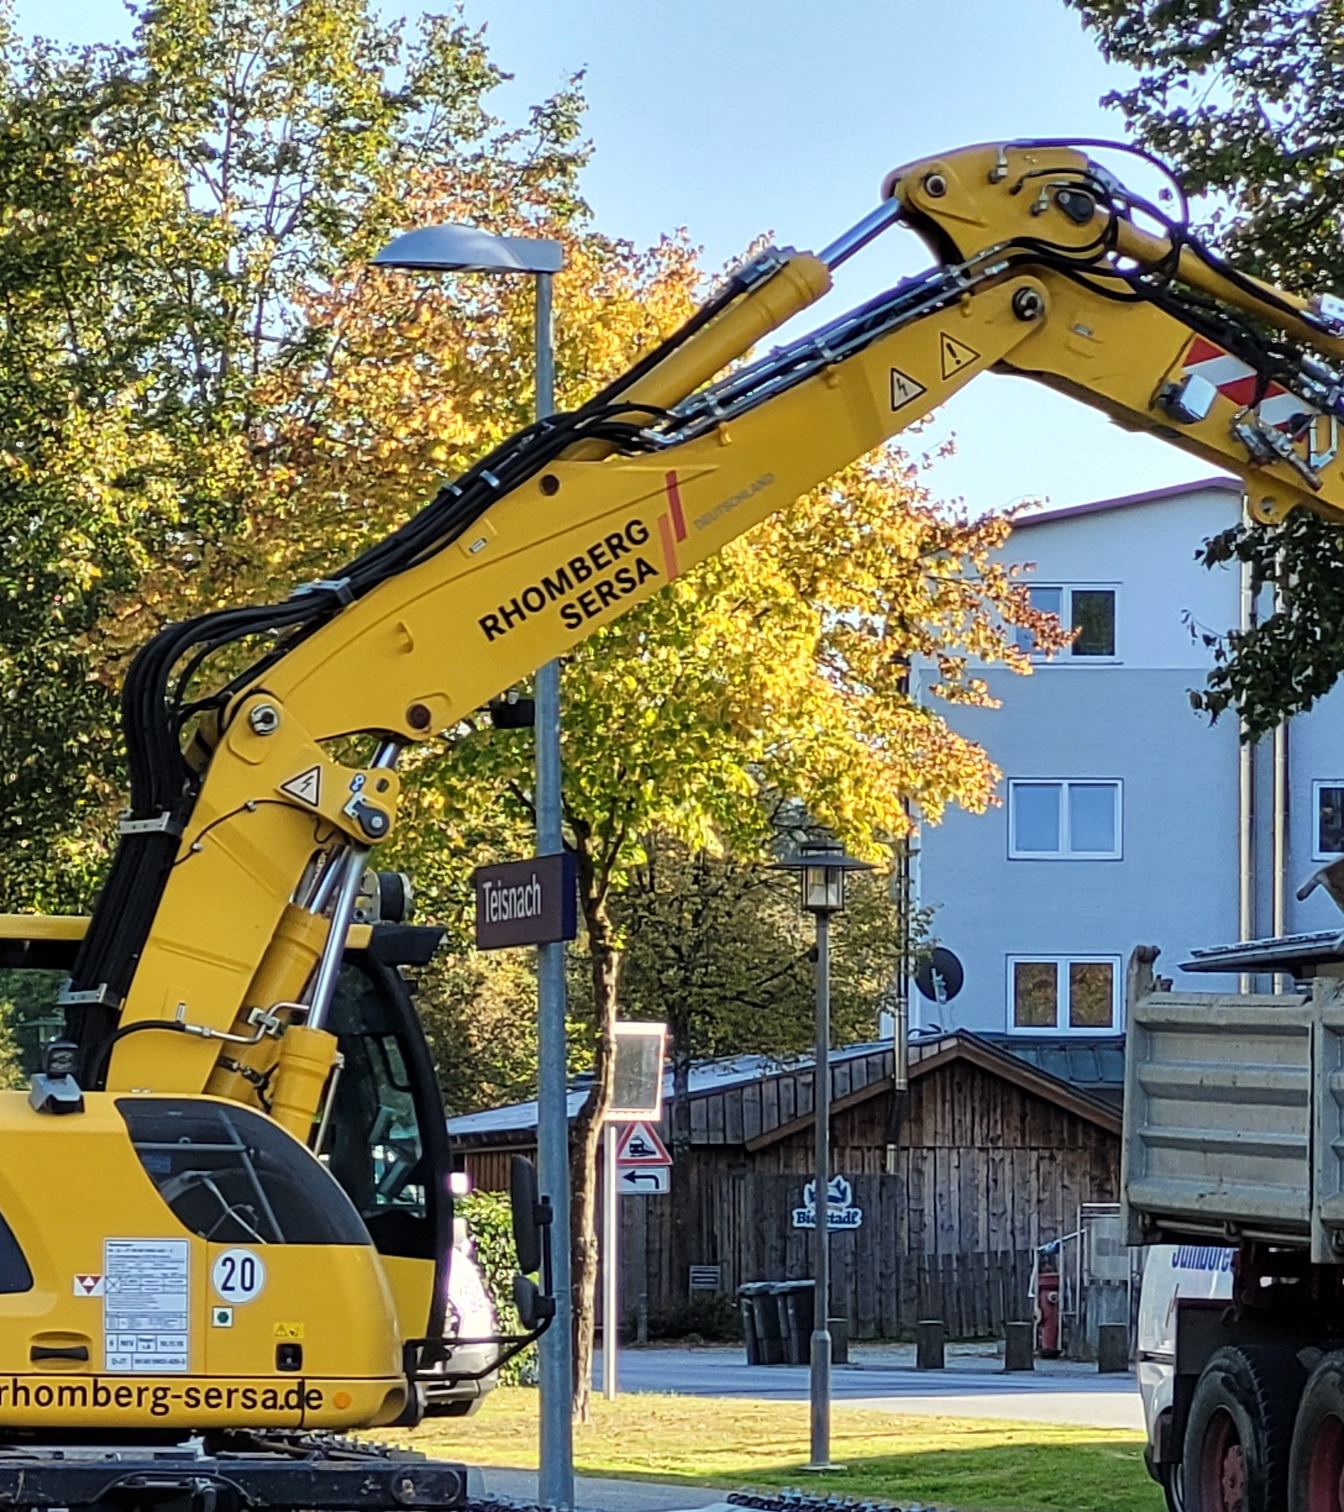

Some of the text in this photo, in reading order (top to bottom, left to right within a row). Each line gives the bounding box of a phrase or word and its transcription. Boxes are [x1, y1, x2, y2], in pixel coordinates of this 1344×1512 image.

[478, 518, 651, 642] RHOMBERG
[559, 557, 660, 631] SERSA
[482, 873, 542, 924] Teisnach
[220, 1256, 256, 1292] 20
